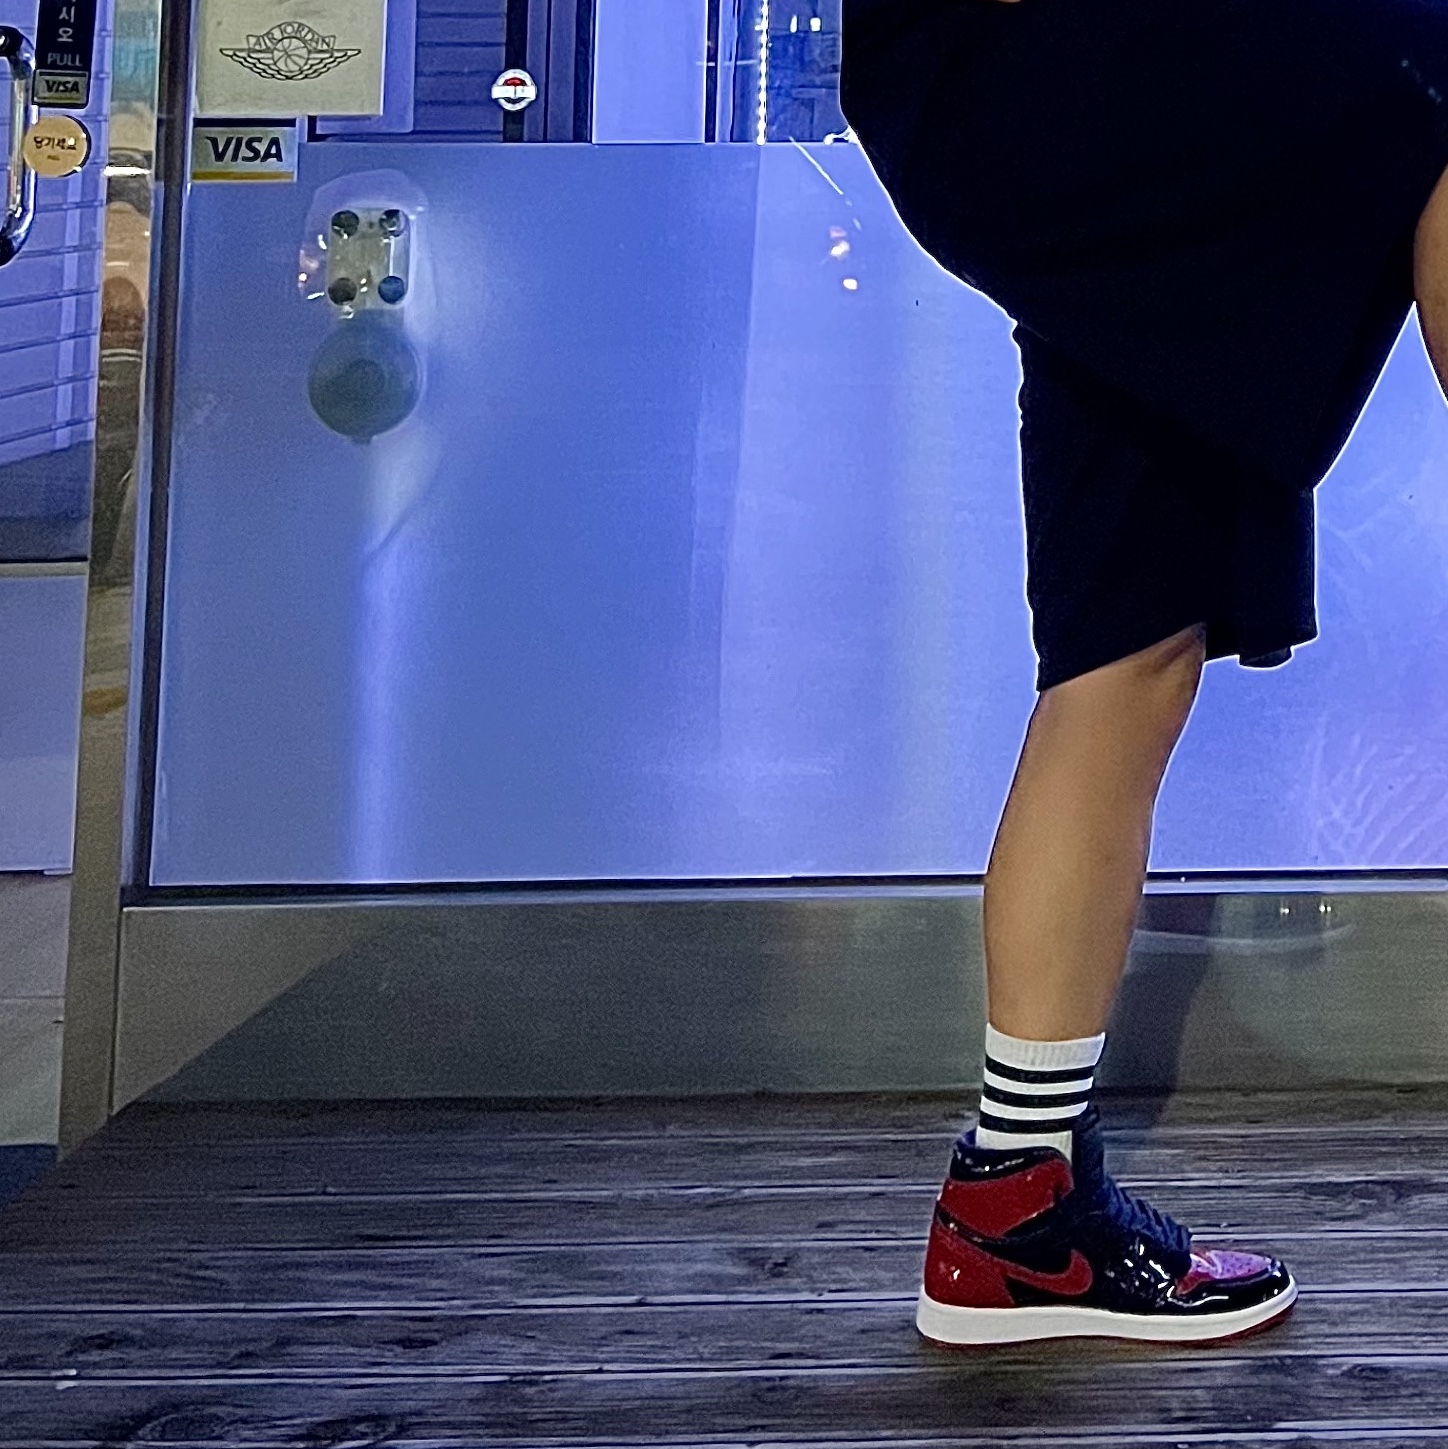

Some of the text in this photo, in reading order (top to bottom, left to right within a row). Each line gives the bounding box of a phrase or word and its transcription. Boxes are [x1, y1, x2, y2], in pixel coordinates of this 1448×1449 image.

[277, 22, 332, 51] JORDAN
[47, 52, 83, 67] PULL
[44, 78, 80, 94] VISA
[203, 136, 283, 163] VISA
